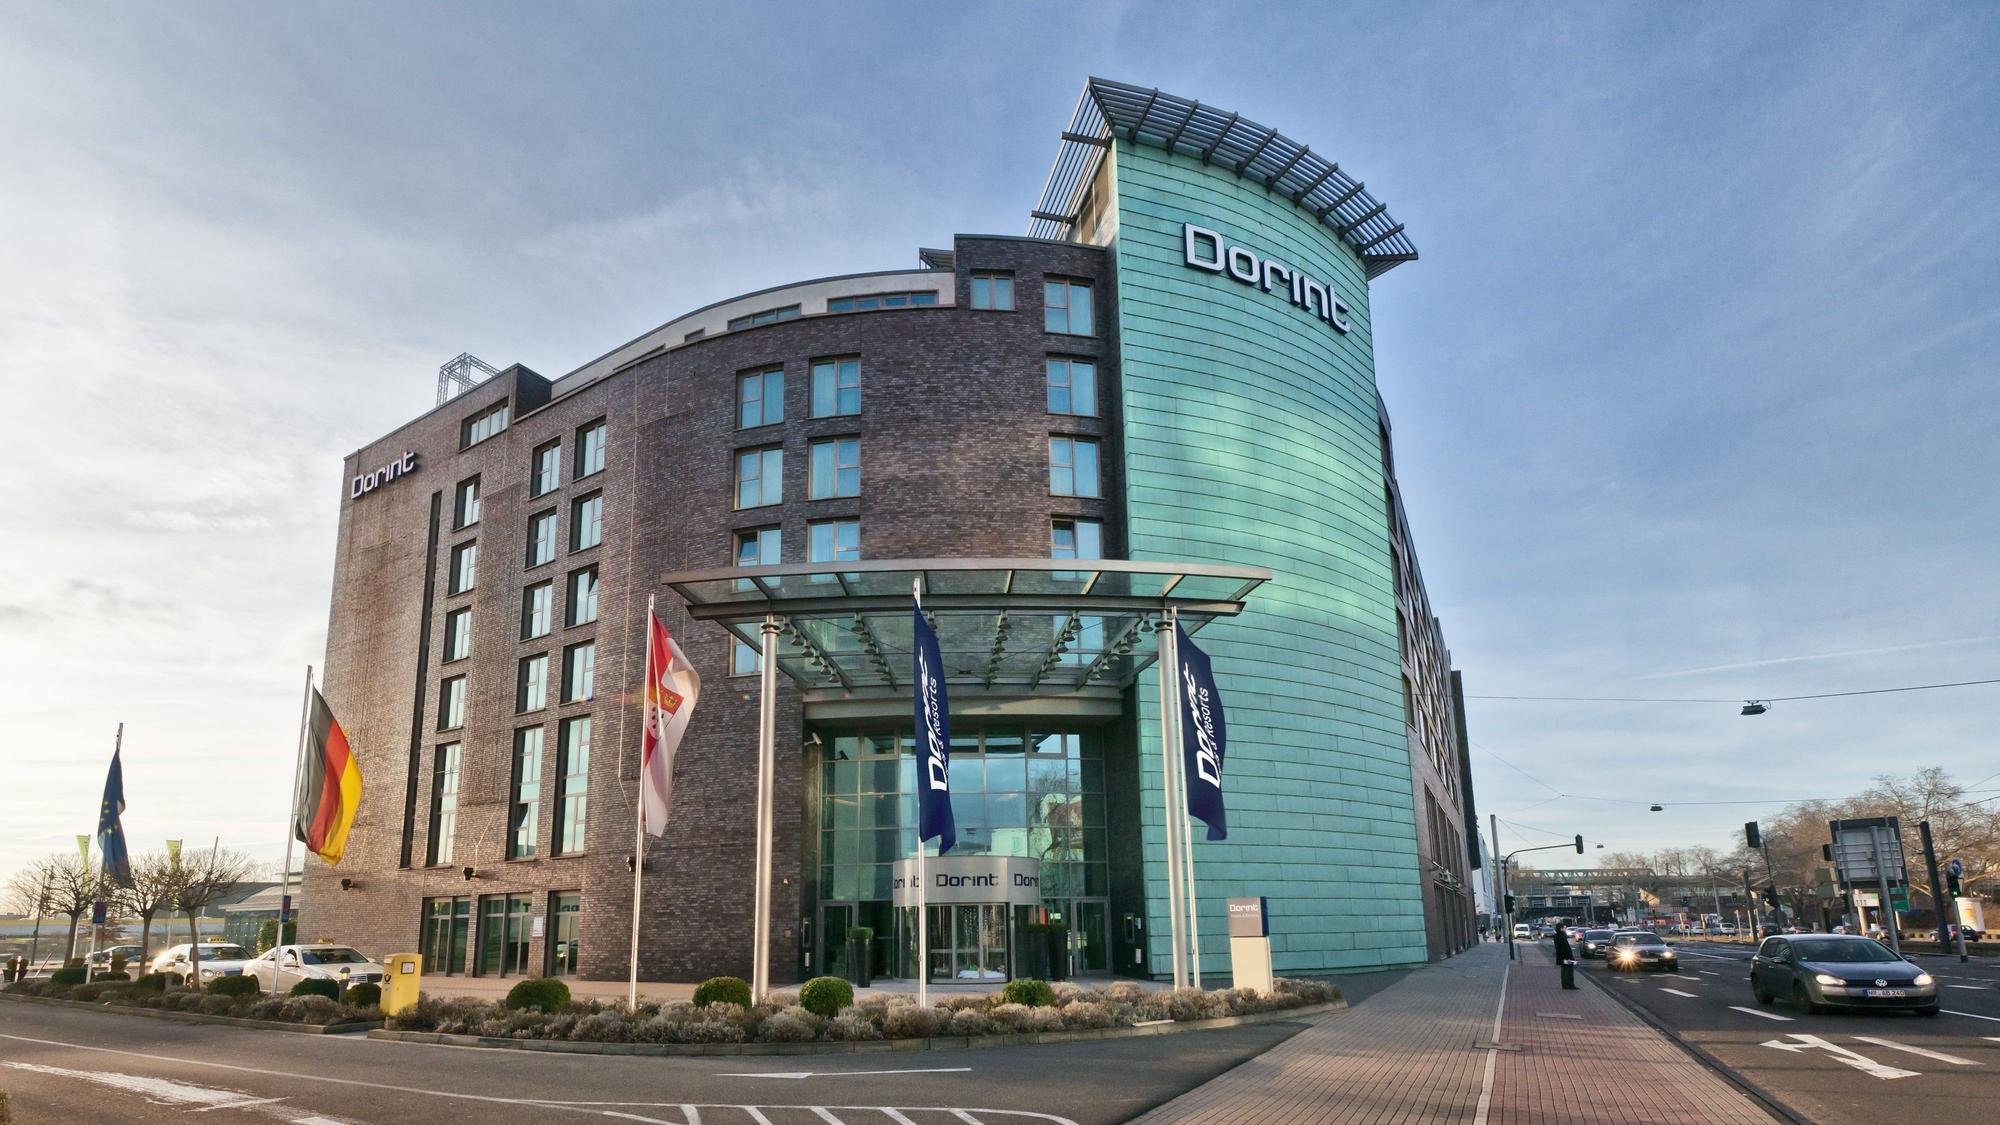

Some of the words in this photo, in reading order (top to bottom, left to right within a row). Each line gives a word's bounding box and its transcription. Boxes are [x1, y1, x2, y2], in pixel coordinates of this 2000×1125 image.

[1184, 223, 1350, 334] Dorint
[351, 451, 415, 499] Dorint
[936, 873, 999, 887] Dorint
[1229, 904, 1259, 912] Dorint
